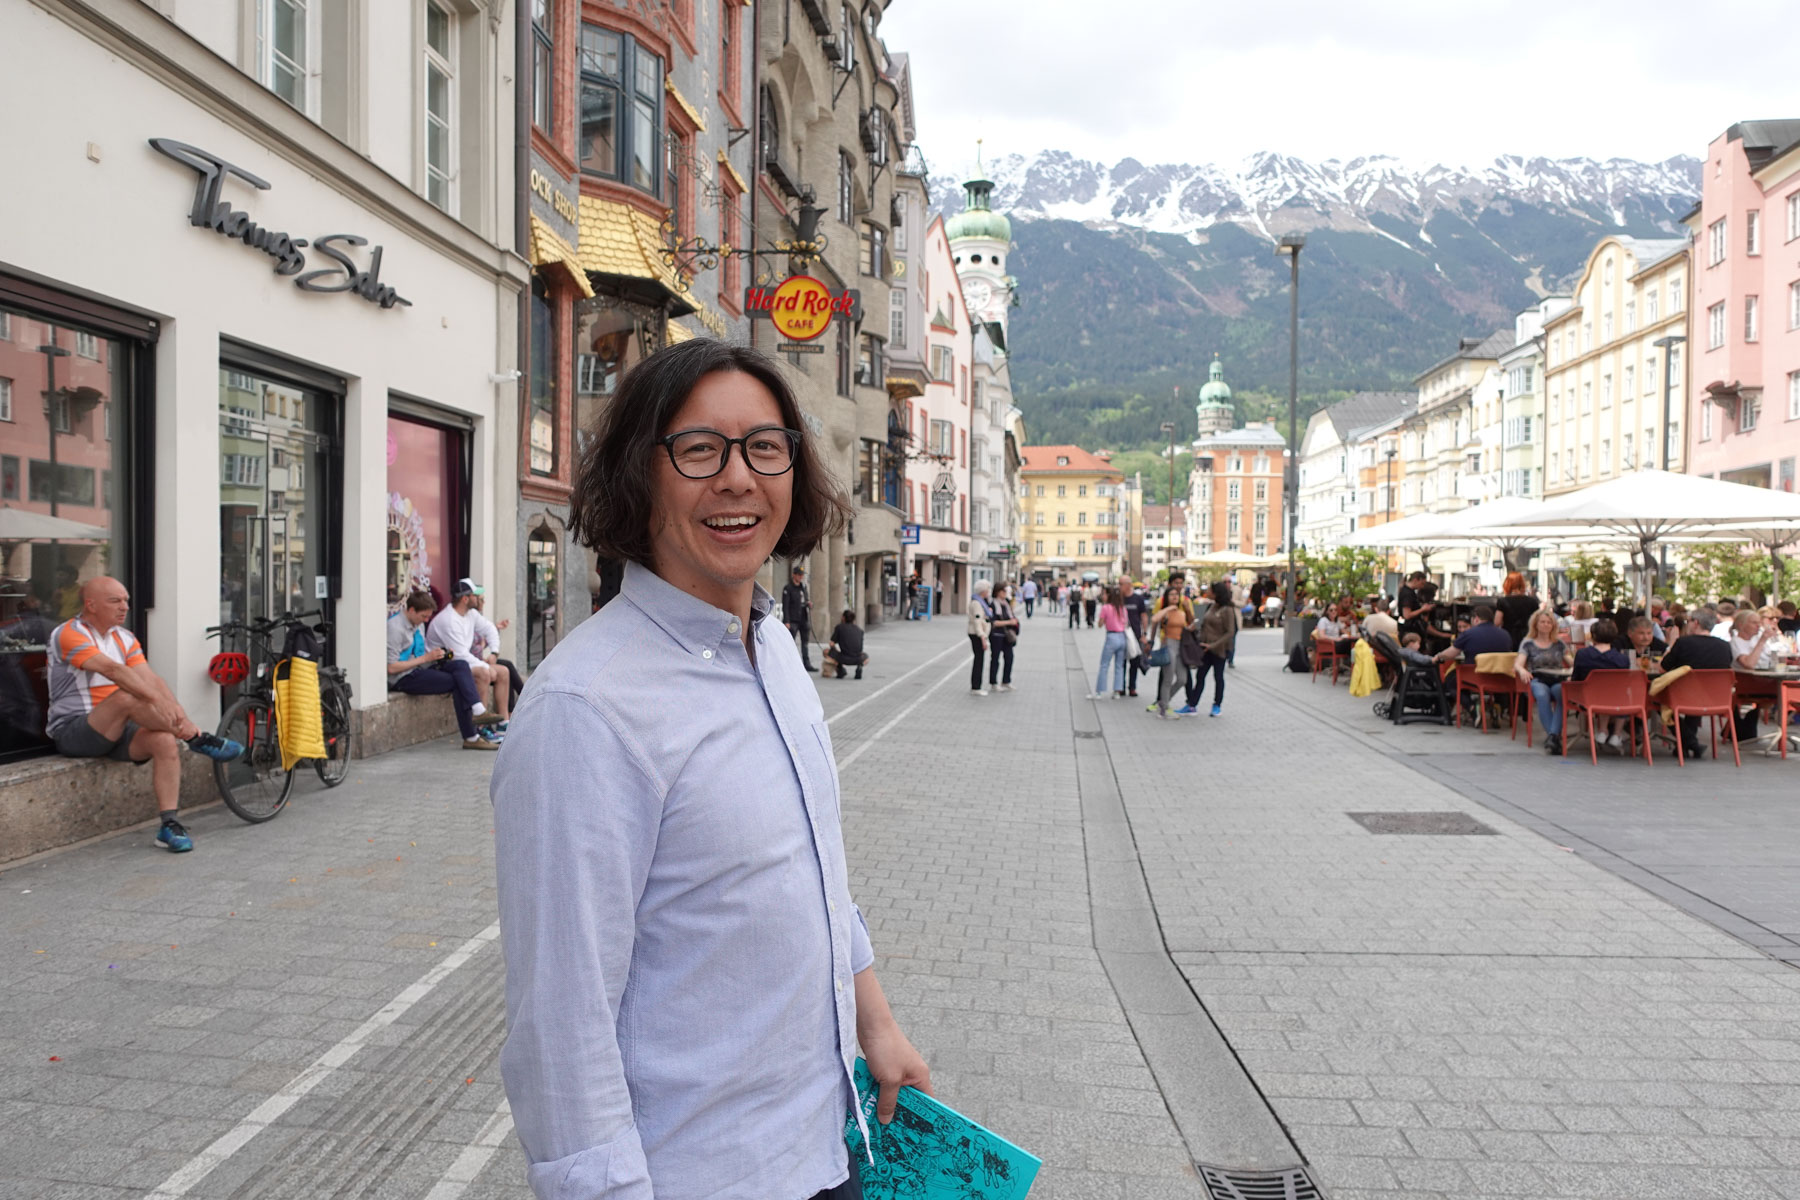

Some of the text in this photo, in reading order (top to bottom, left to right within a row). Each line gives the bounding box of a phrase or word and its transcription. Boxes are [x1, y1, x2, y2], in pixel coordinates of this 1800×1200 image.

[554, 188, 577, 225] SHOP
[746, 287, 855, 317] Hard Rock
[787, 319, 815, 330] CAFE
